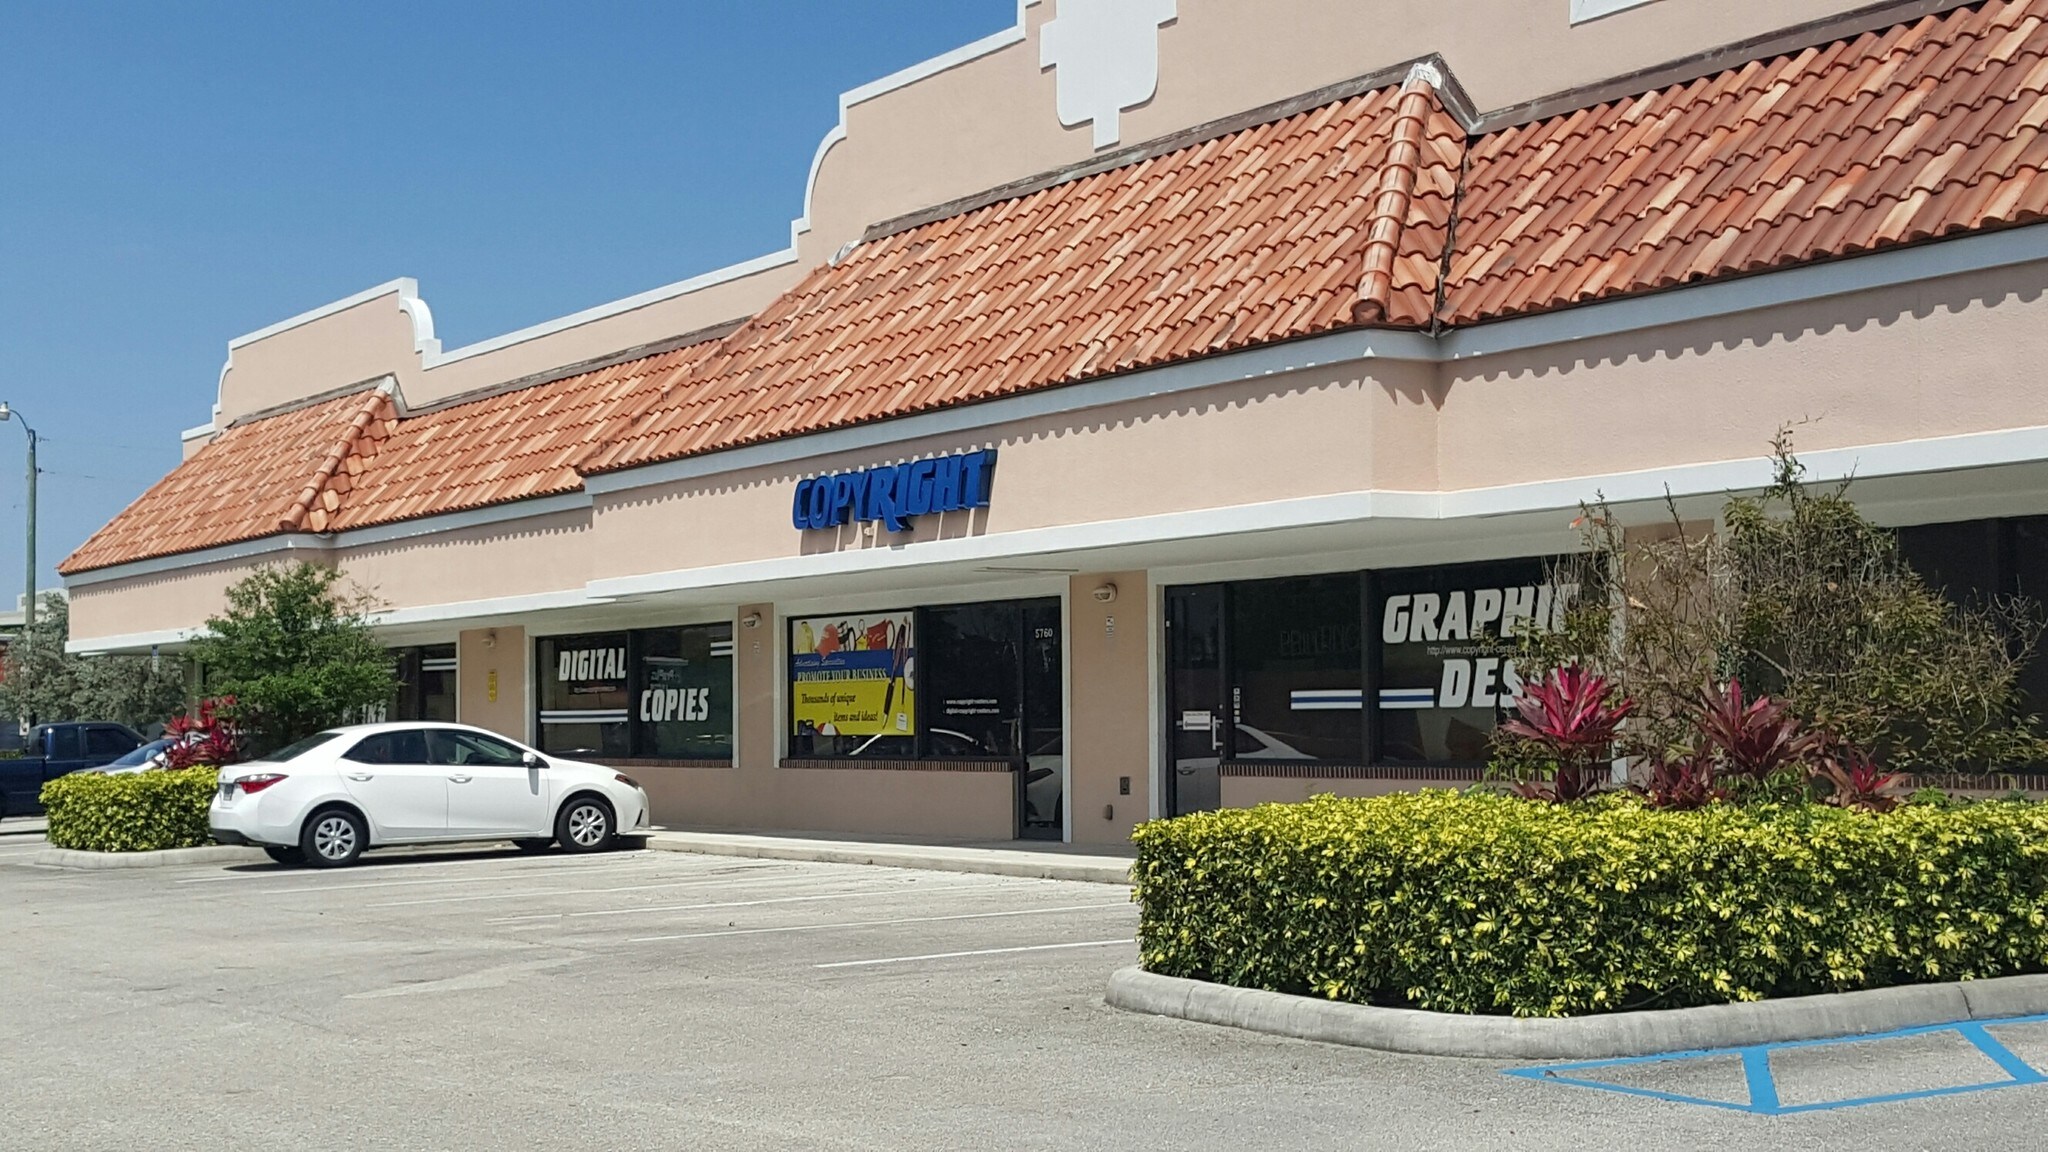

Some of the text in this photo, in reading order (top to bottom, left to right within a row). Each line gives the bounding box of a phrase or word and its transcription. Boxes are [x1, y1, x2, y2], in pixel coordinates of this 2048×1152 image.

[792, 448, 998, 533] COPYRIGHT
[1035, 628, 1053, 639] 5760
[558, 647, 627, 682] DIGITAL
[797, 667, 887, 682] PROMOTE YOUR BUSINESS
[640, 687, 709, 722] COPIES
[801, 692, 856, 707] Thousands of unique
[834, 710, 879, 722] items and ideas!
